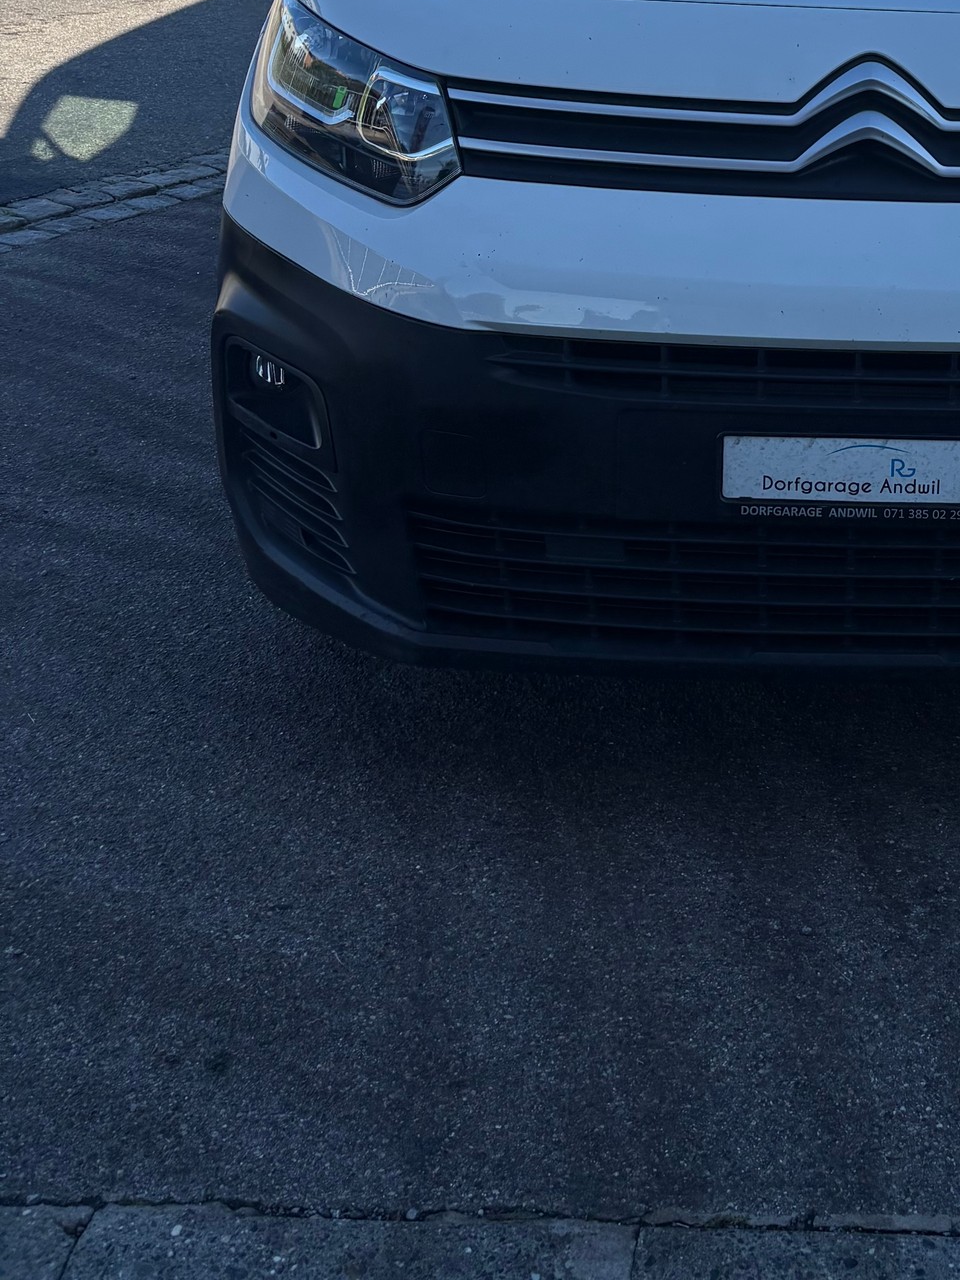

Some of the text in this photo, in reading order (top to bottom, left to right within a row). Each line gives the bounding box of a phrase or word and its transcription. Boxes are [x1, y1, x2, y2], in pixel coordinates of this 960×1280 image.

[762, 474, 940, 496] Dorfgarage Andwil
[740, 505, 823, 518] DORFGARAGE
[828, 507, 878, 519] ANDWIL
[883, 508, 905, 519] 071
[908, 509, 929, 520] 385
[932, 509, 947, 520] 02
